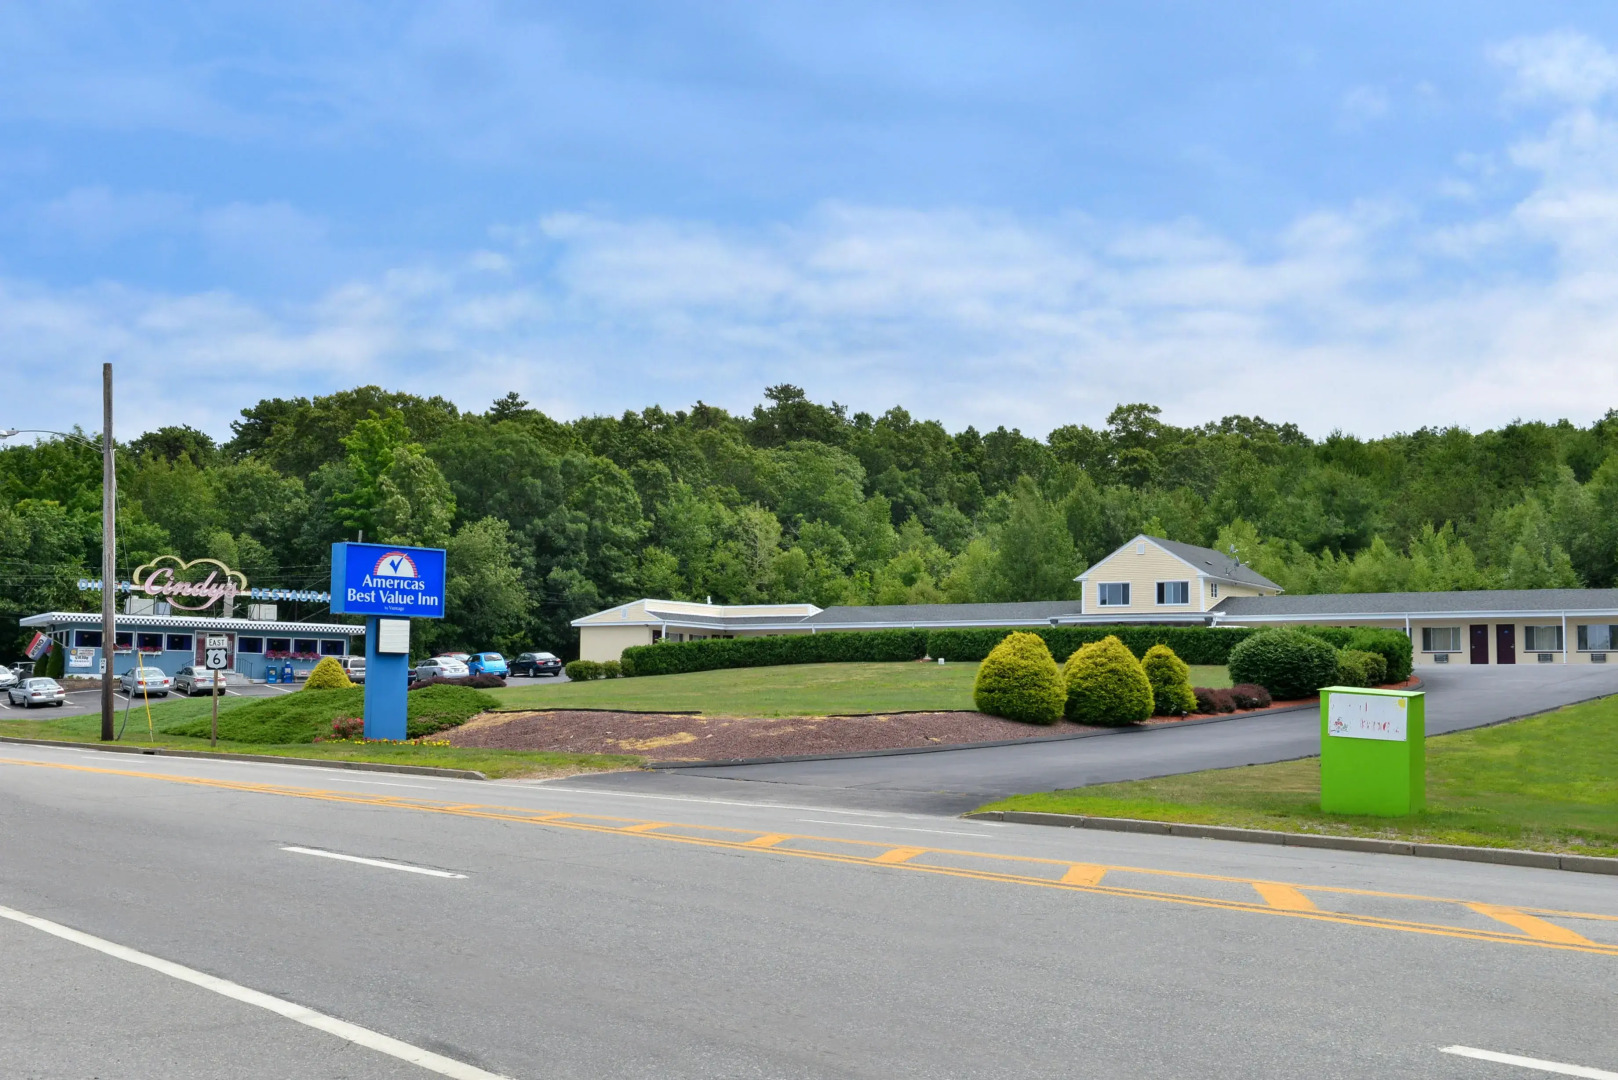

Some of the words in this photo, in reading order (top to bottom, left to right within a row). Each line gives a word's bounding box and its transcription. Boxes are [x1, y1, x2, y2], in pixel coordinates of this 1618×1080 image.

[144, 568, 240, 610] Cindy's
[362, 574, 425, 590] Americas
[251, 587, 330, 603] RESTAURA
[347, 588, 376, 603] Best
[379, 590, 415, 604] Value
[418, 592, 439, 606] Inn
[209, 638, 225, 646] EAST
[212, 653, 221, 665] 6
